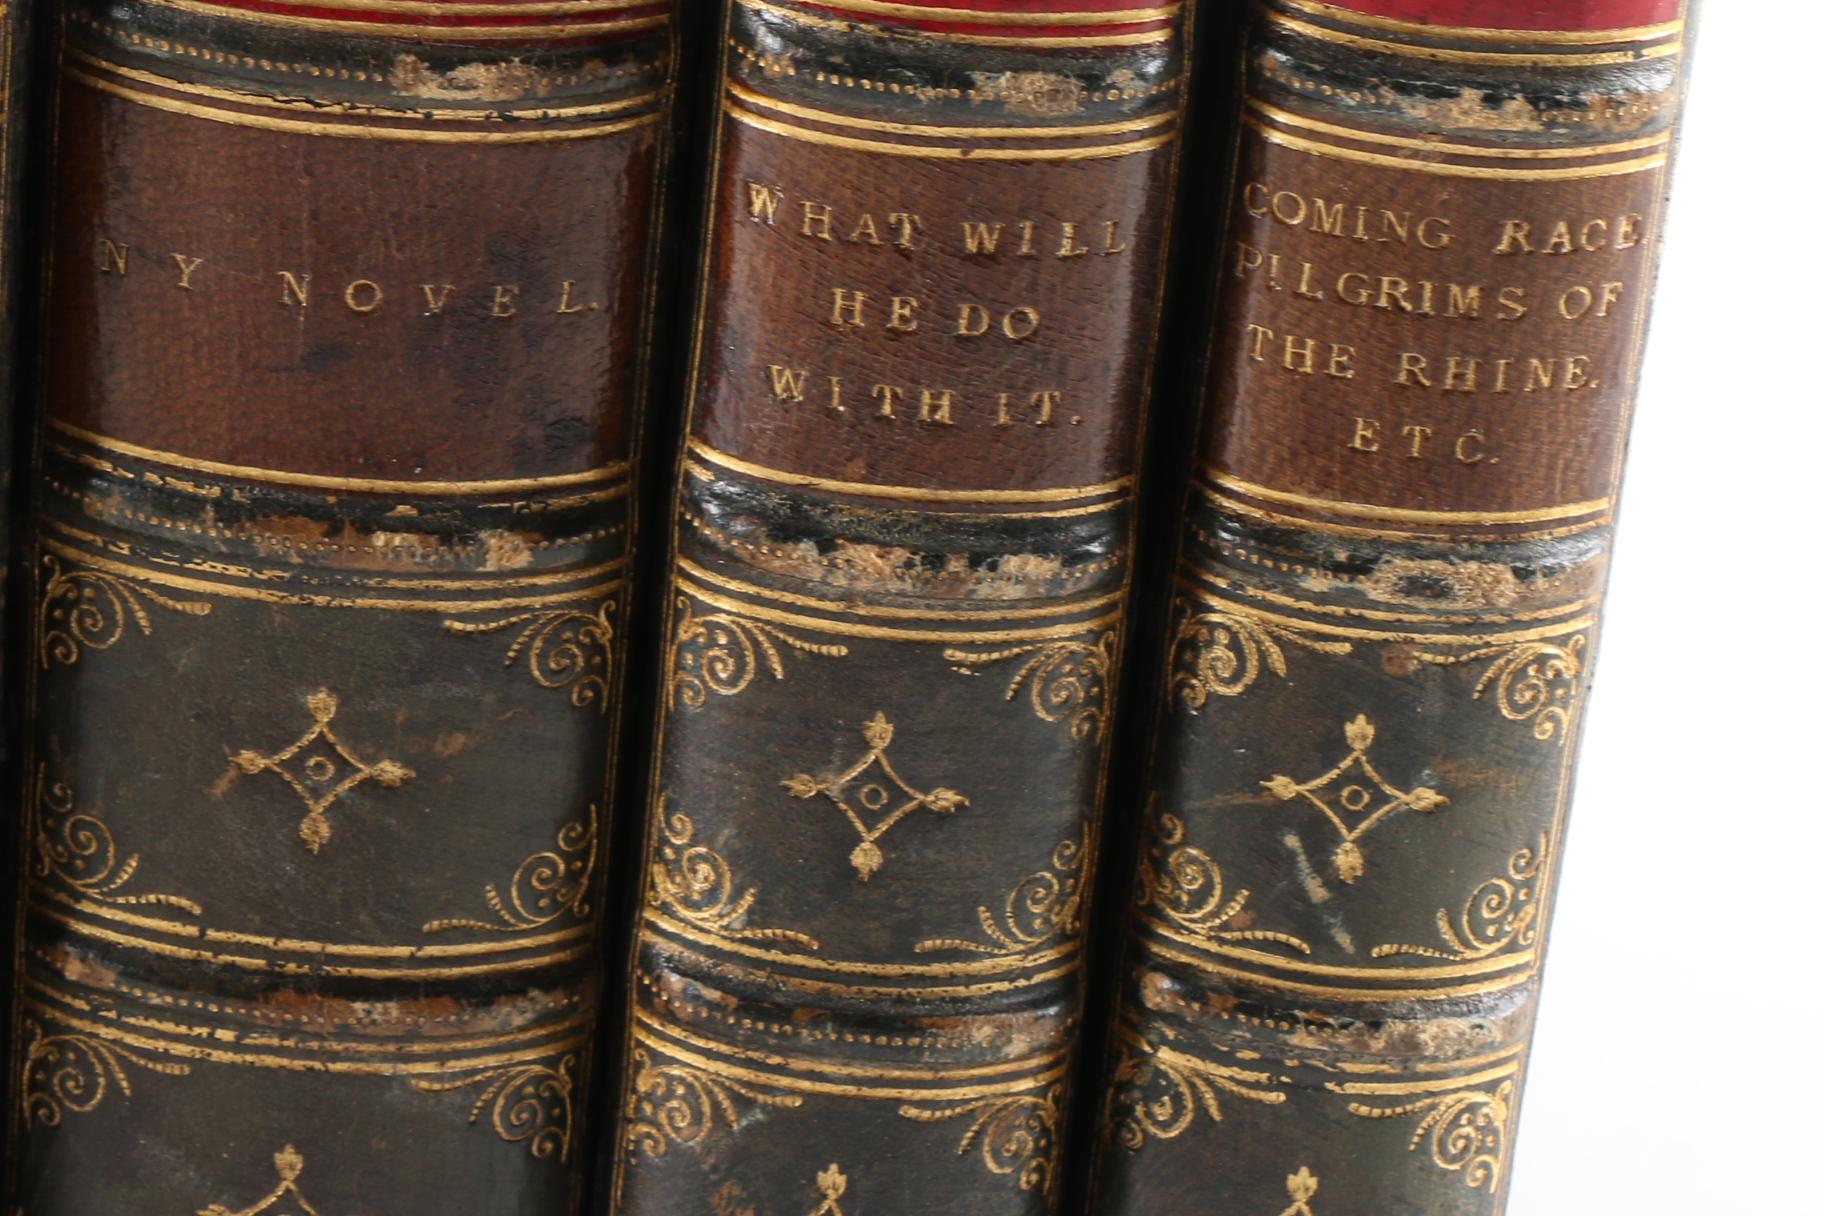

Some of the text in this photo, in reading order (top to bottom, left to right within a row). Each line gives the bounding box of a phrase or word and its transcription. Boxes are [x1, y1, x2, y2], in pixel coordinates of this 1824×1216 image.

[747, 179, 1127, 257] WHAT WILL
[1243, 182, 1455, 250] COMING
[278, 271, 599, 317] NOVEL.
[831, 287, 1040, 340] HE DO
[1233, 241, 1624, 322] PILGRIMS OF
[1246, 323, 1600, 393] THE RHINE.
[768, 364, 1083, 426] WITH IT.
[1347, 417, 1500, 464] ETC.
